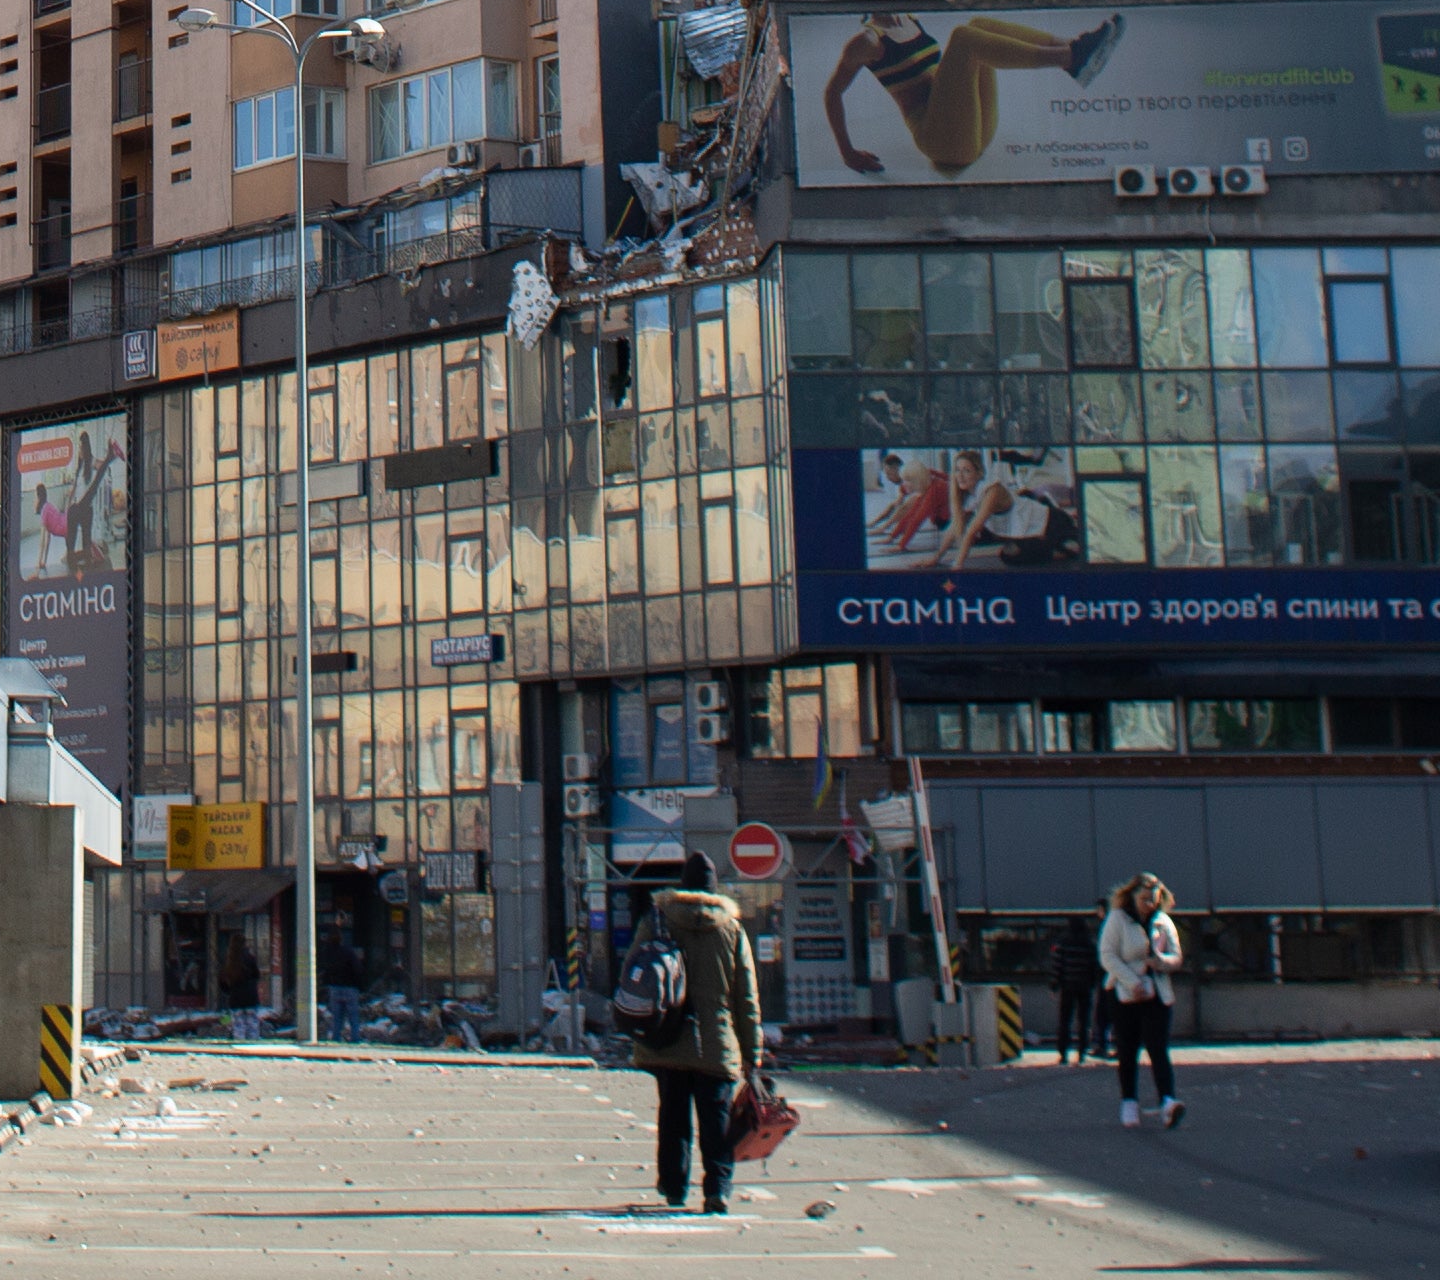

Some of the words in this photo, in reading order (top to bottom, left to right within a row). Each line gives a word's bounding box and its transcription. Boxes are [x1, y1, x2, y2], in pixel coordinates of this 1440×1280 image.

[1051, 93, 1132, 116] простір
[1138, 96, 1192, 111] твого
[1046, 594, 1141, 626] Центр
[1149, 593, 1278, 625] здоров'я
[1287, 598, 1380, 619] спини
[1387, 598, 1423, 619] та
[19, 638, 48, 654] Центр
[433, 635, 490, 654] НОТАРІУС
[203, 809, 251, 823] ТАЙСЬКИЙ
[210, 825, 243, 835] МАСАЖ
